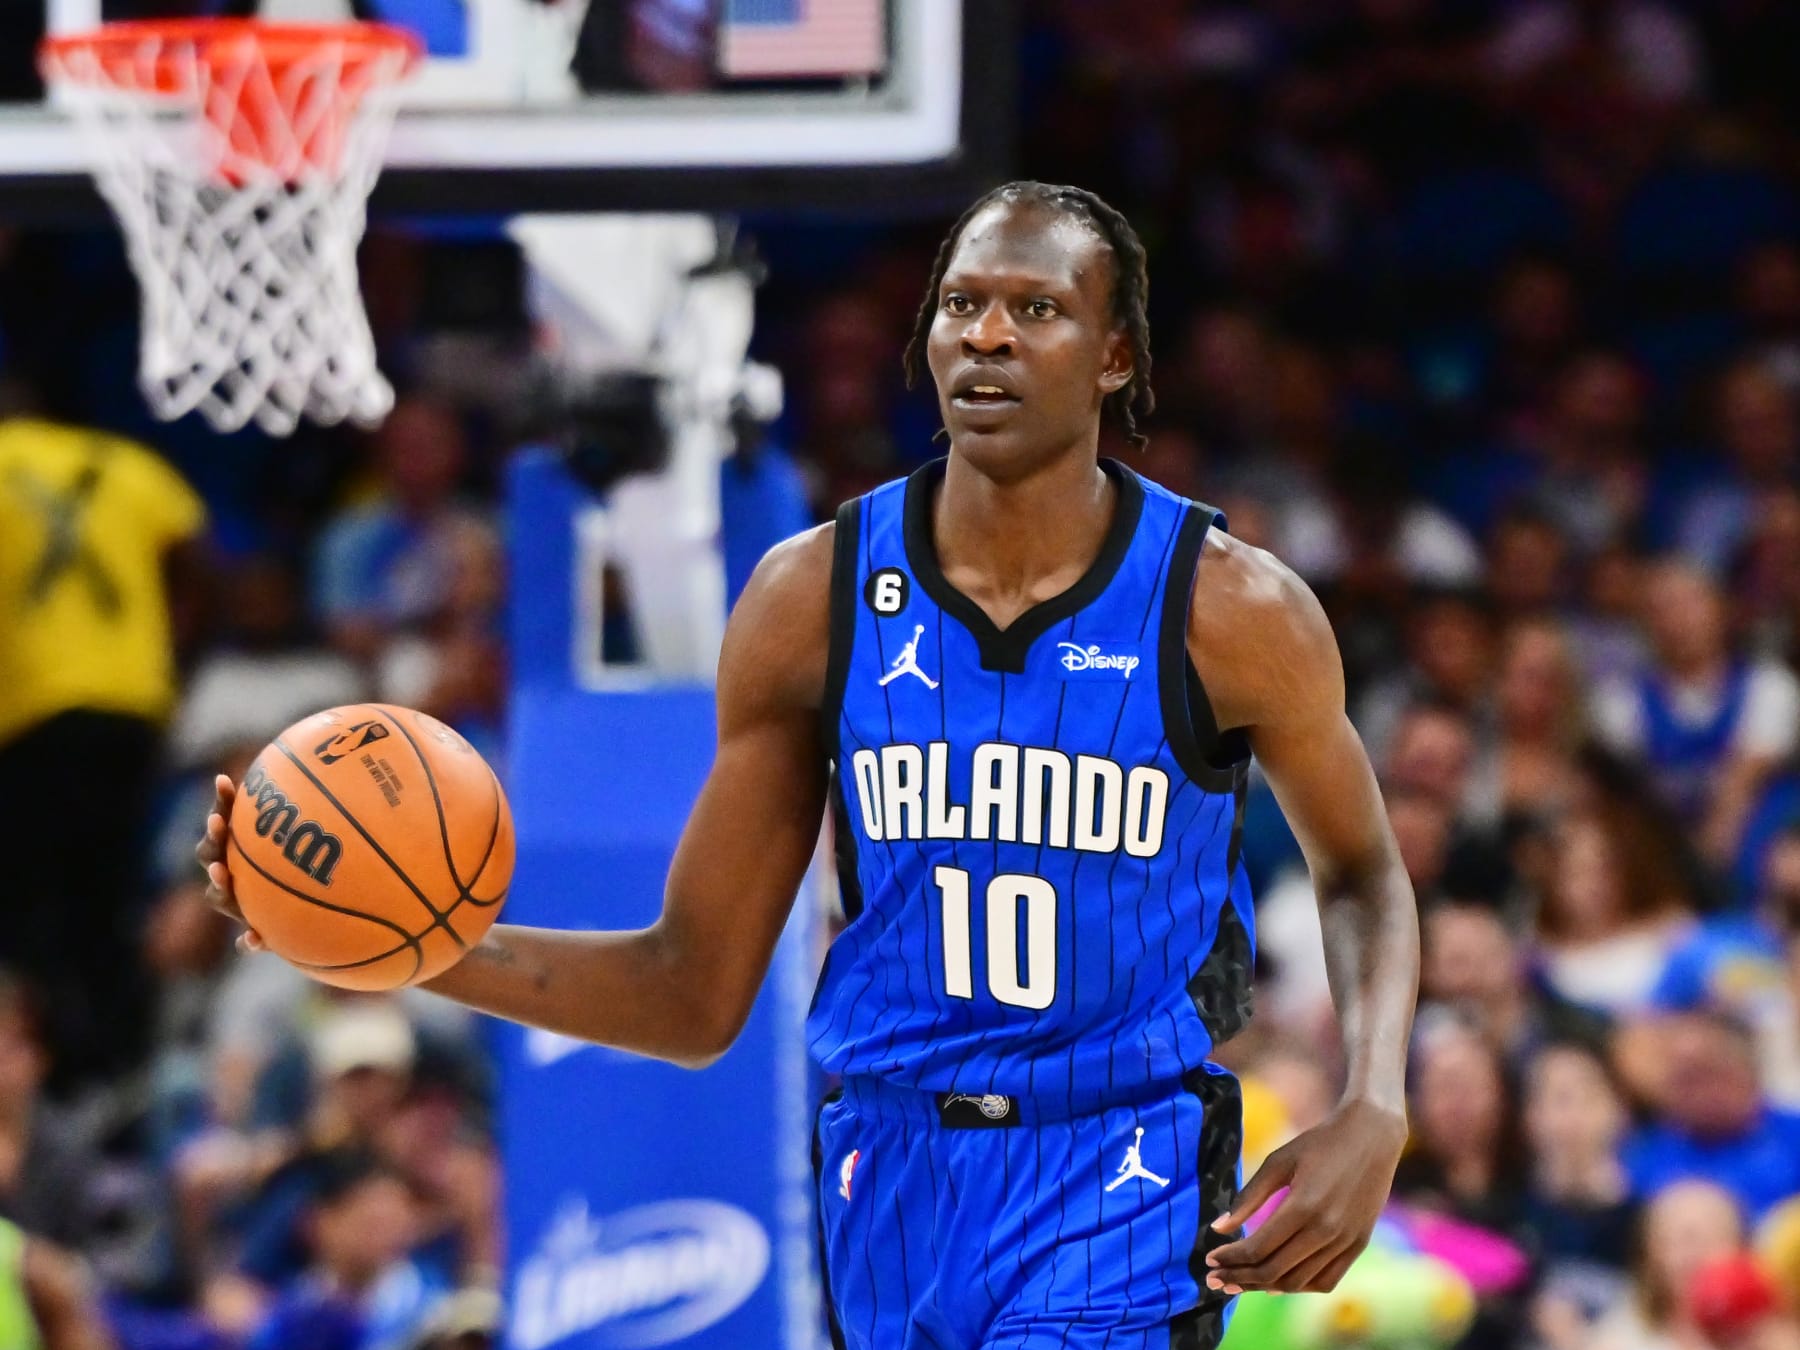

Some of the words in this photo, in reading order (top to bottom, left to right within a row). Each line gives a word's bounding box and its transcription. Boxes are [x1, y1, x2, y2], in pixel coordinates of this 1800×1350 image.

[874, 574, 902, 612] 6
[243, 766, 344, 888] Wilso
[853, 742, 1169, 858] ORLANDO
[934, 865, 1057, 1010] 10
